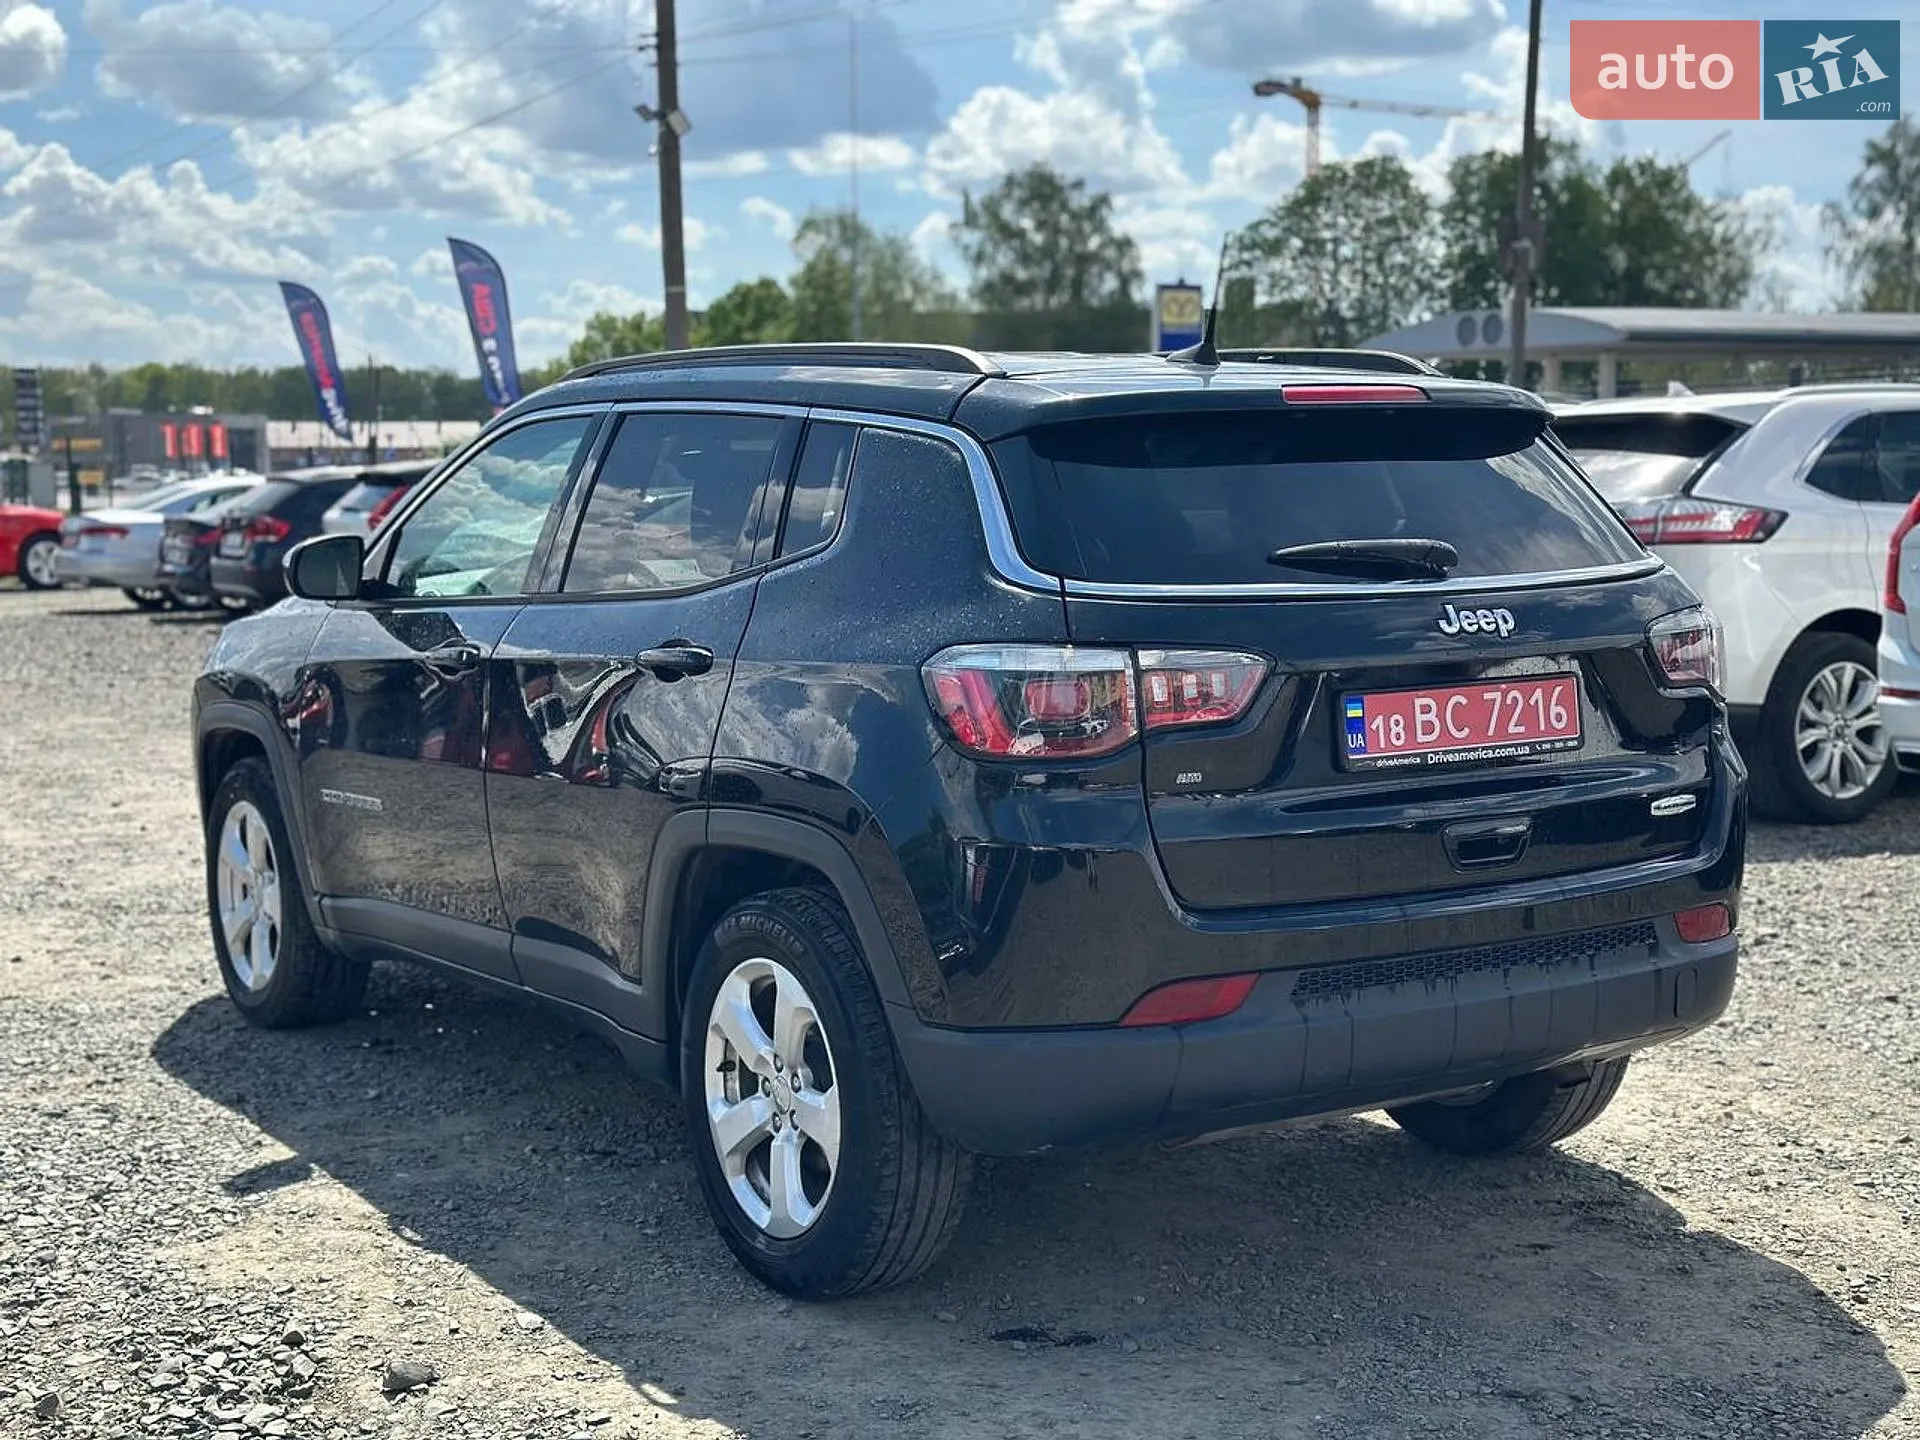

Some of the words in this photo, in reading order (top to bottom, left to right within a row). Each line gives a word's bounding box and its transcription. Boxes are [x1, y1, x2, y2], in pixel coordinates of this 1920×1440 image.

[1438, 604, 1515, 637] Jeep
[1369, 713, 1406, 749] 18
[1413, 694, 1471, 743] BC
[1483, 685, 1568, 737] 7216
[1347, 733, 1365, 749] UA
[1427, 745, 1530, 764] Driveamerica.com.ua
